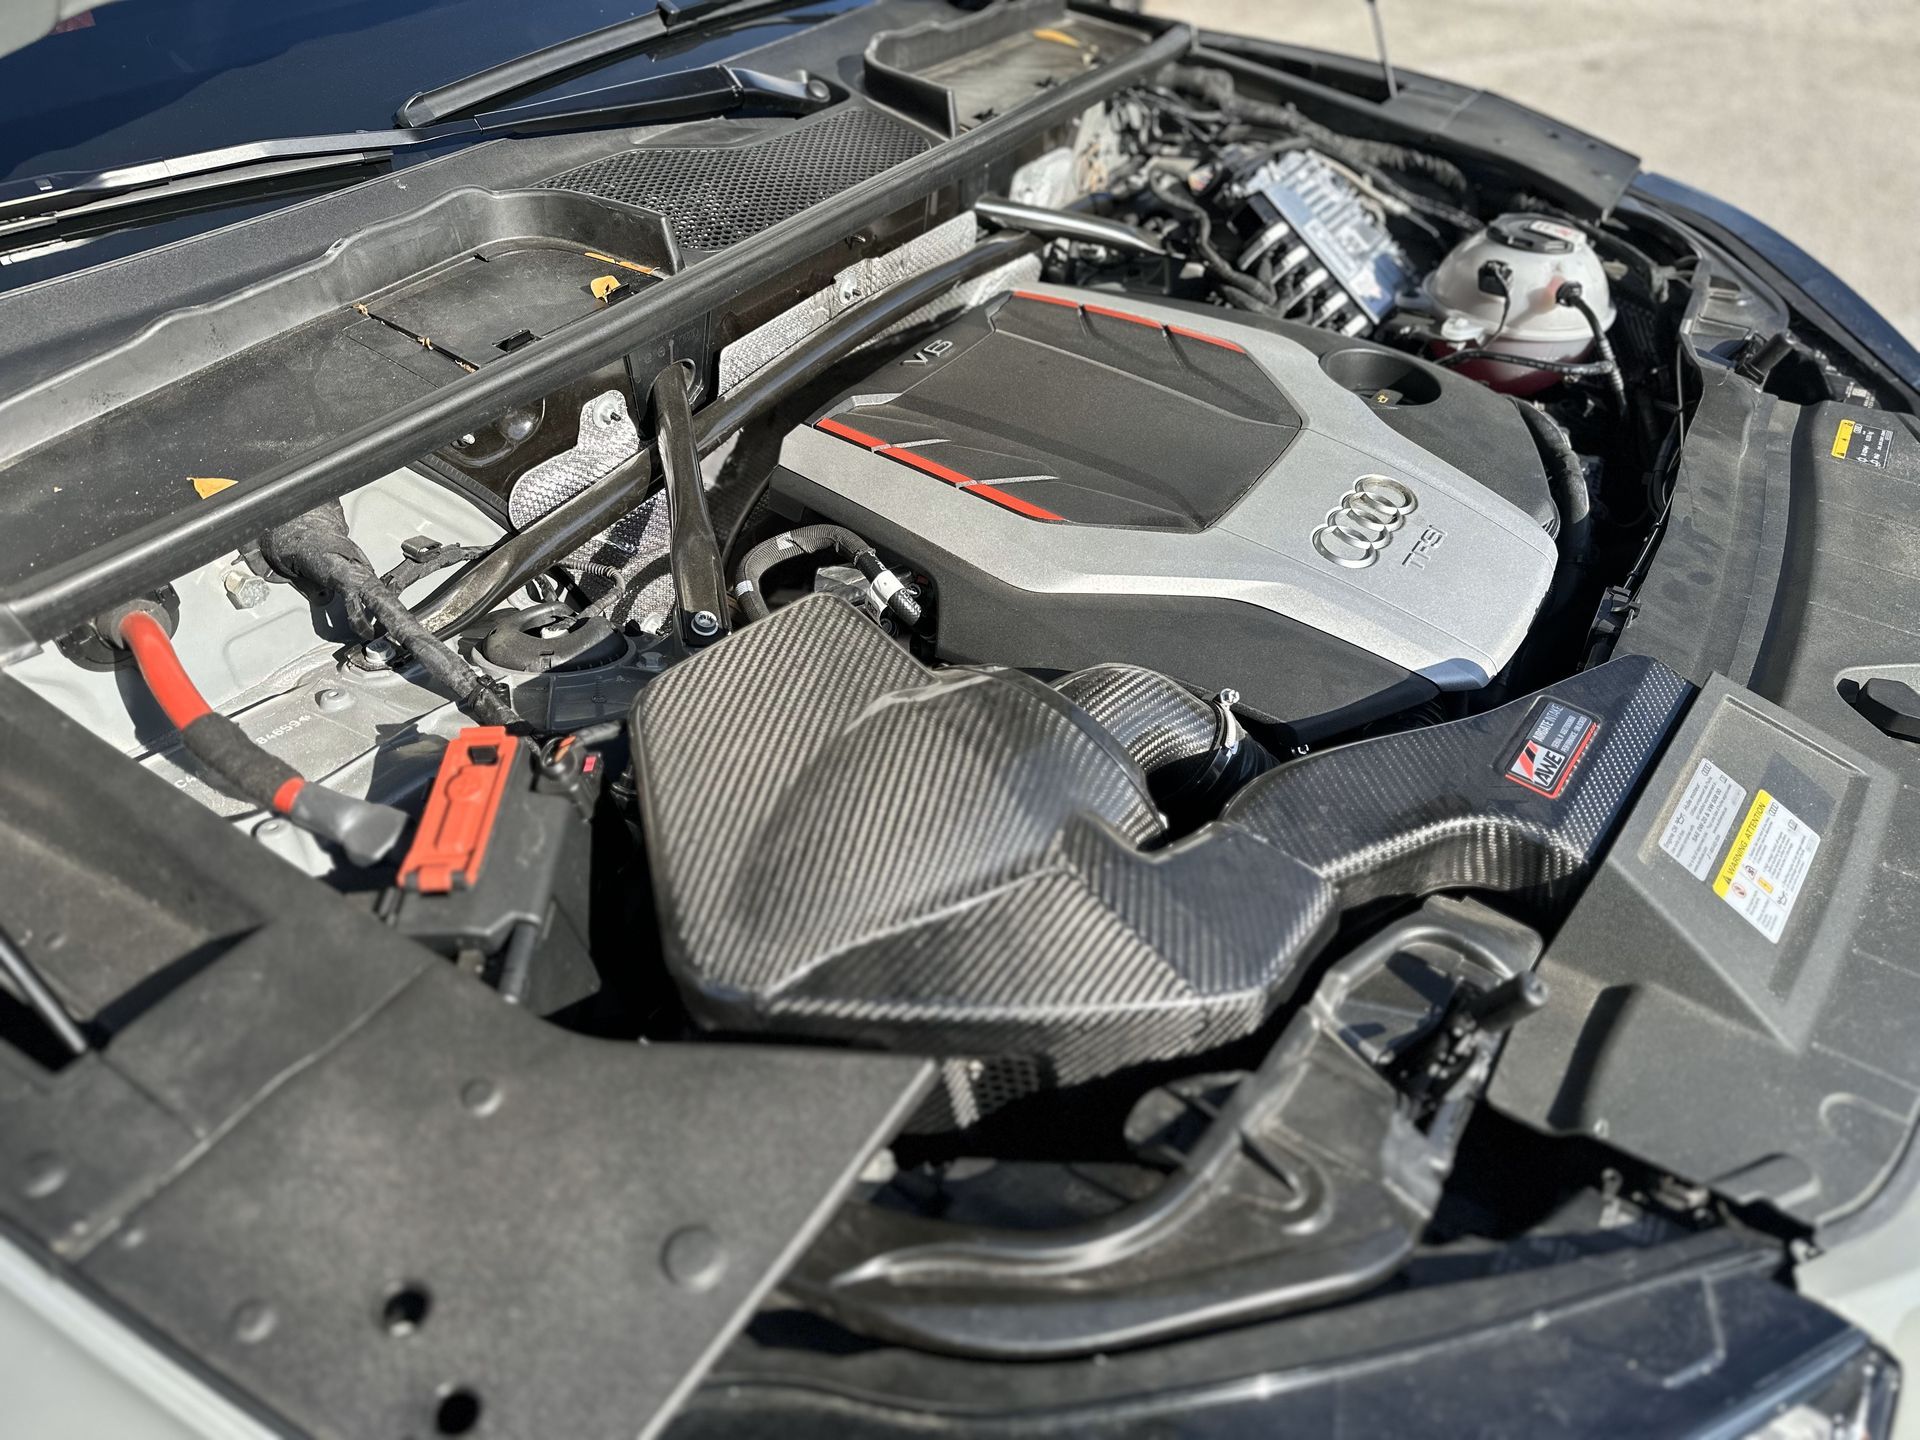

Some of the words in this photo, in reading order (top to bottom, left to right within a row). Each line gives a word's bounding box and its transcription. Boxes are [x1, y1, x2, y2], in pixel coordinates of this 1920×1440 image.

[901, 339, 953, 366] V6
[1402, 524, 1447, 569] TFSI
[1545, 704, 1564, 723] INTAKE
[1534, 751, 1562, 785] AWE
[1727, 840, 1748, 876] WARNING
[1745, 802, 1765, 840] ATTENTION
